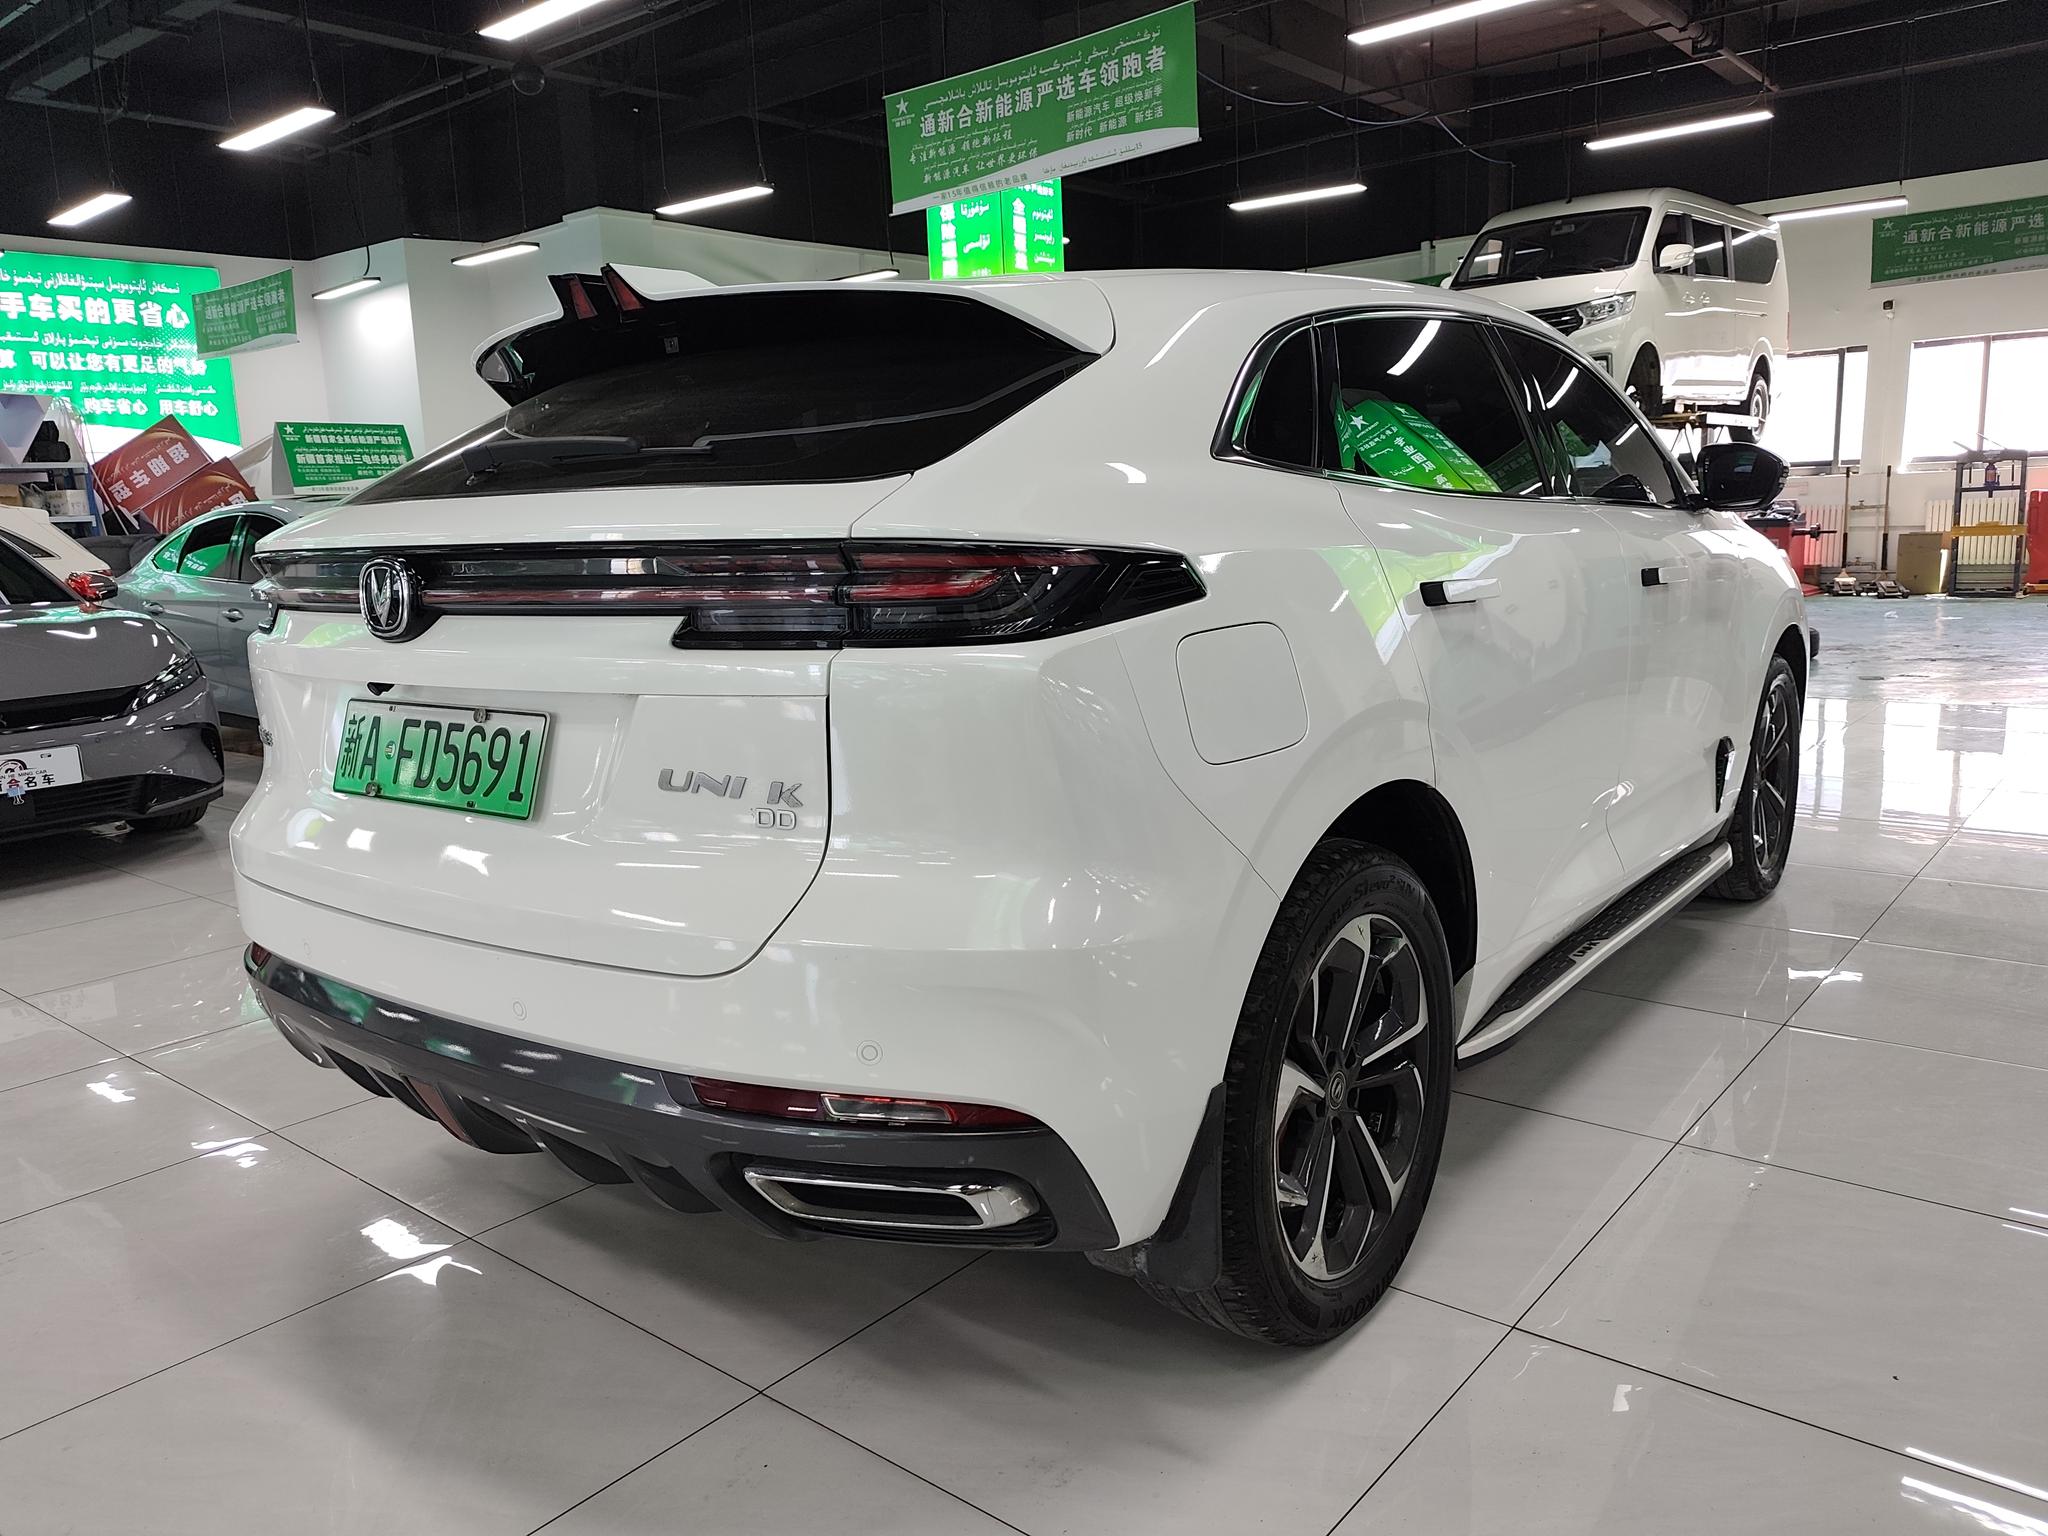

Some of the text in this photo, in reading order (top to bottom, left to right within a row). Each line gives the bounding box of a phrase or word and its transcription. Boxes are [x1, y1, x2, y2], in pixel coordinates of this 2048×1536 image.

[920, 45, 1167, 138] 通新合新能源严选车领跑者
[1066, 100, 1111, 123] 新能源汽车
[1066, 126, 1093, 142] 新时代
[1099, 115, 1128, 133] 新能源
[1135, 105, 1164, 124] 新生活
[1903, 213, 2045, 244] 通新合新能源严选
[0, 291, 190, 329] 手车买的更省心
[0, 773, 55, 792] 合名车
